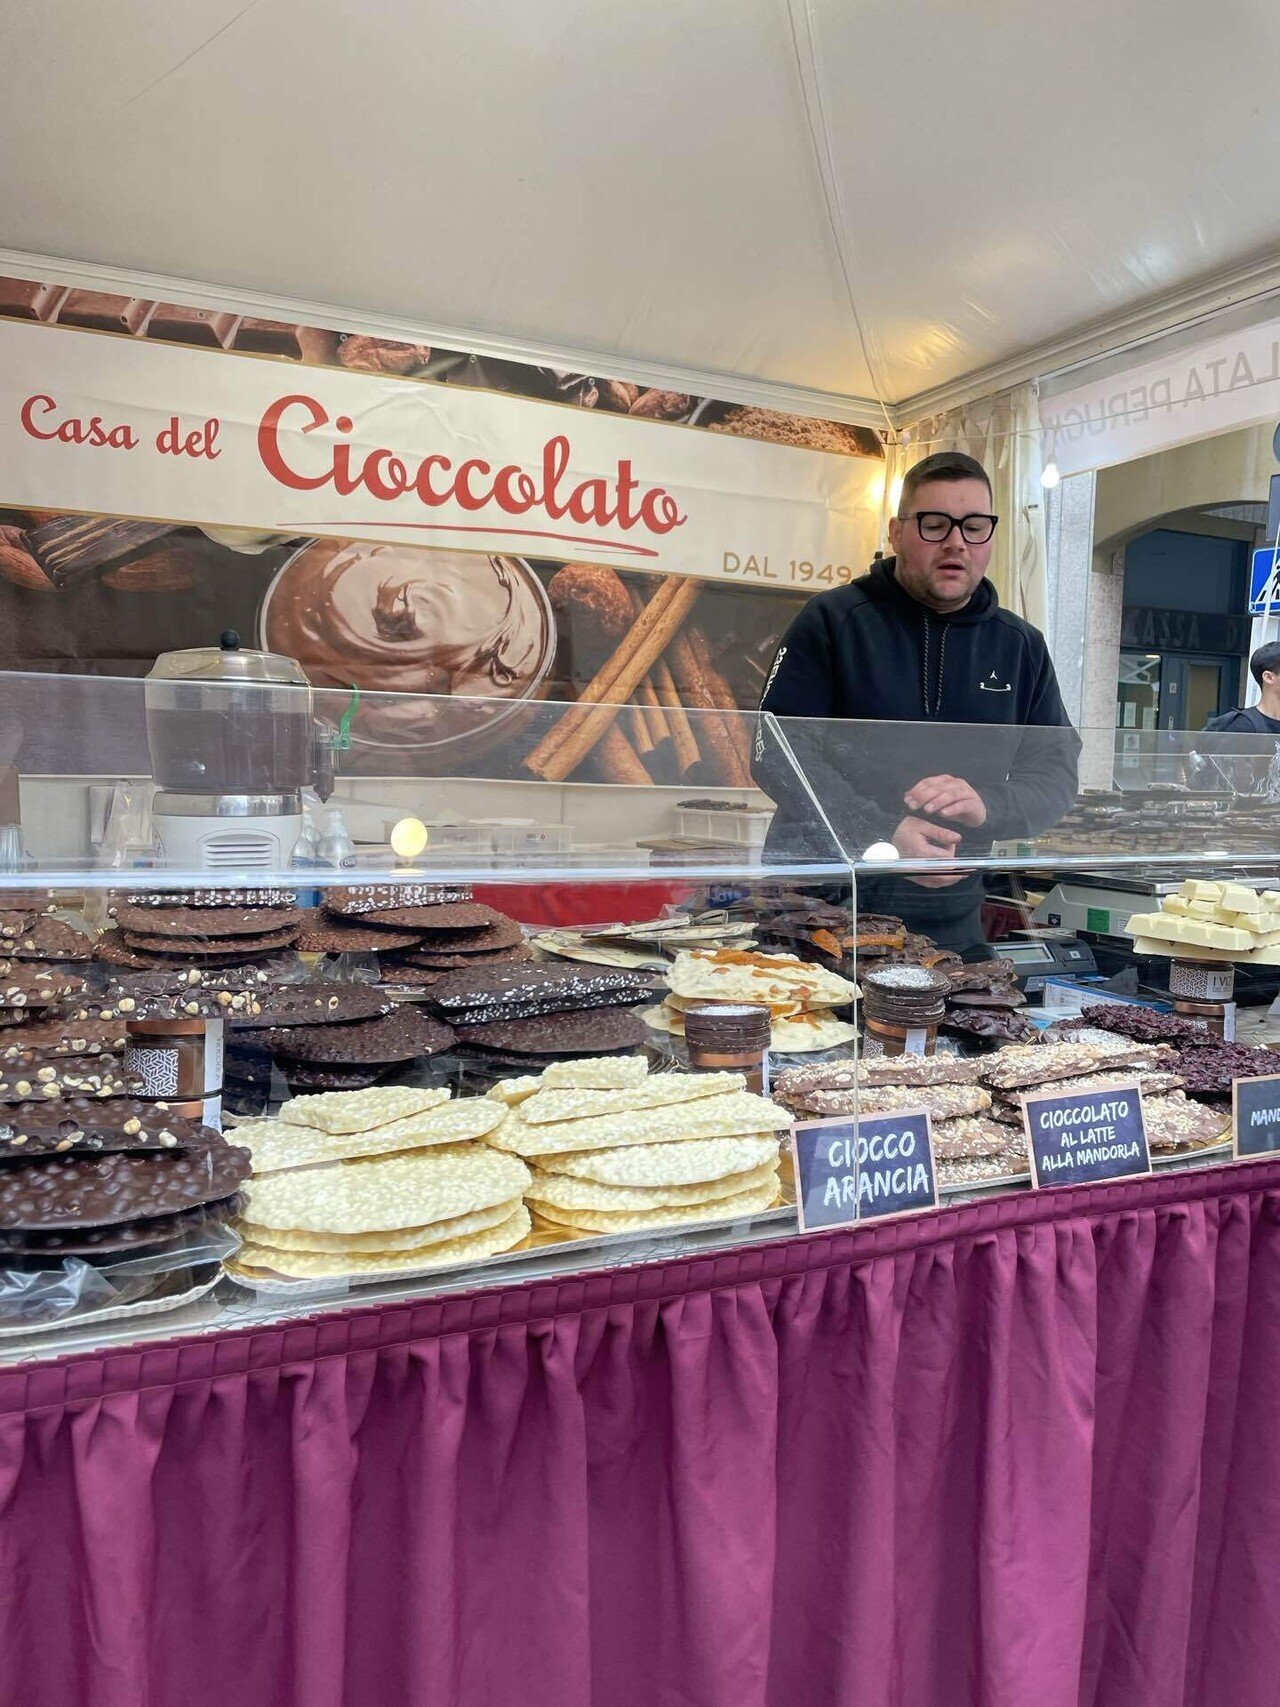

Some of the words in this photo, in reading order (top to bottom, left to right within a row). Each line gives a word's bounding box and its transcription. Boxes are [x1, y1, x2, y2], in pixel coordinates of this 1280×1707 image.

[21, 394, 139, 450] Casa
[156, 417, 222, 460] del
[257, 394, 688, 535] Cioccolato
[722, 551, 778, 579] DAL
[788, 559, 853, 585] 1949
[1040, 1100, 1129, 1131] CIOCCOLATO
[828, 1130, 917, 1168] CIOCCO
[1060, 1131, 1078, 1148] AL
[1080, 1126, 1117, 1146] LATTE
[1042, 1152, 1075, 1172] ALLA
[1076, 1141, 1141, 1166] MANDORLA
[823, 1163, 930, 1209] ARANCIA
